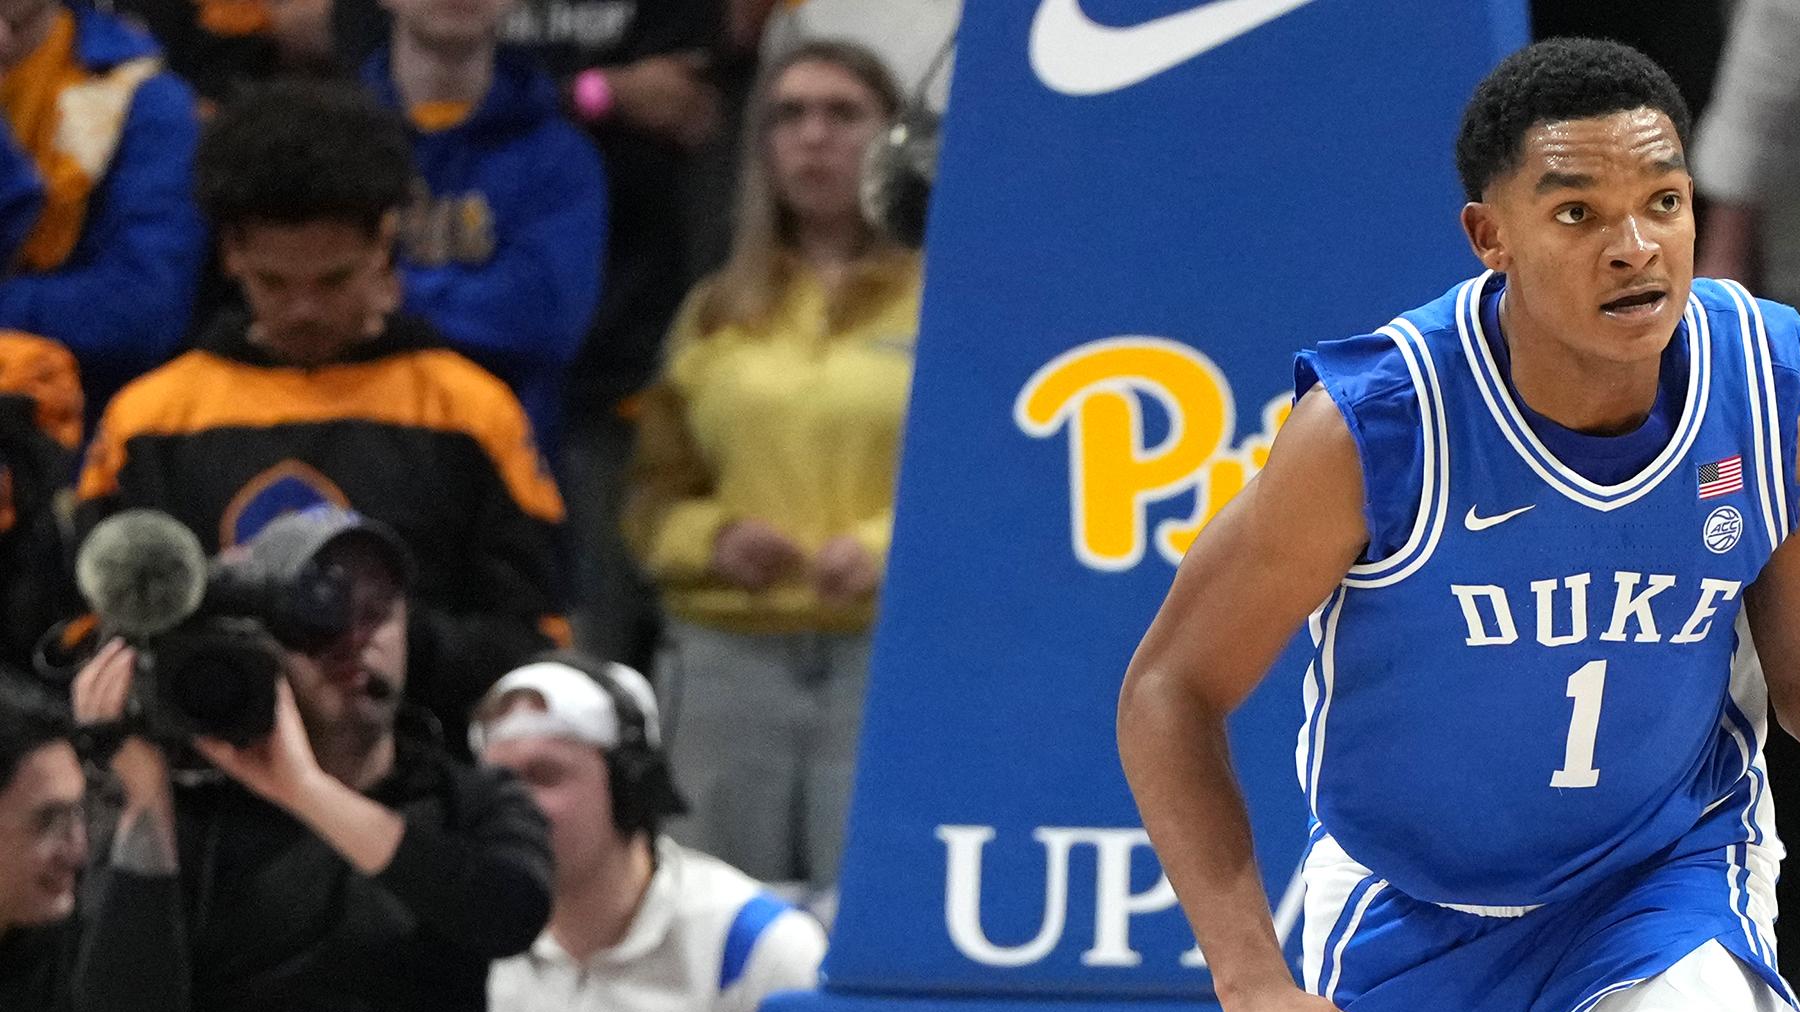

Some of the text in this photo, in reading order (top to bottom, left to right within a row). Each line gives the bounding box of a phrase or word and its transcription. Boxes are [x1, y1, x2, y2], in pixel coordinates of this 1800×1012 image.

[1710, 519, 1740, 534] ACC
[1450, 571, 1742, 647] DUKE
[1549, 659, 1607, 788] 1
